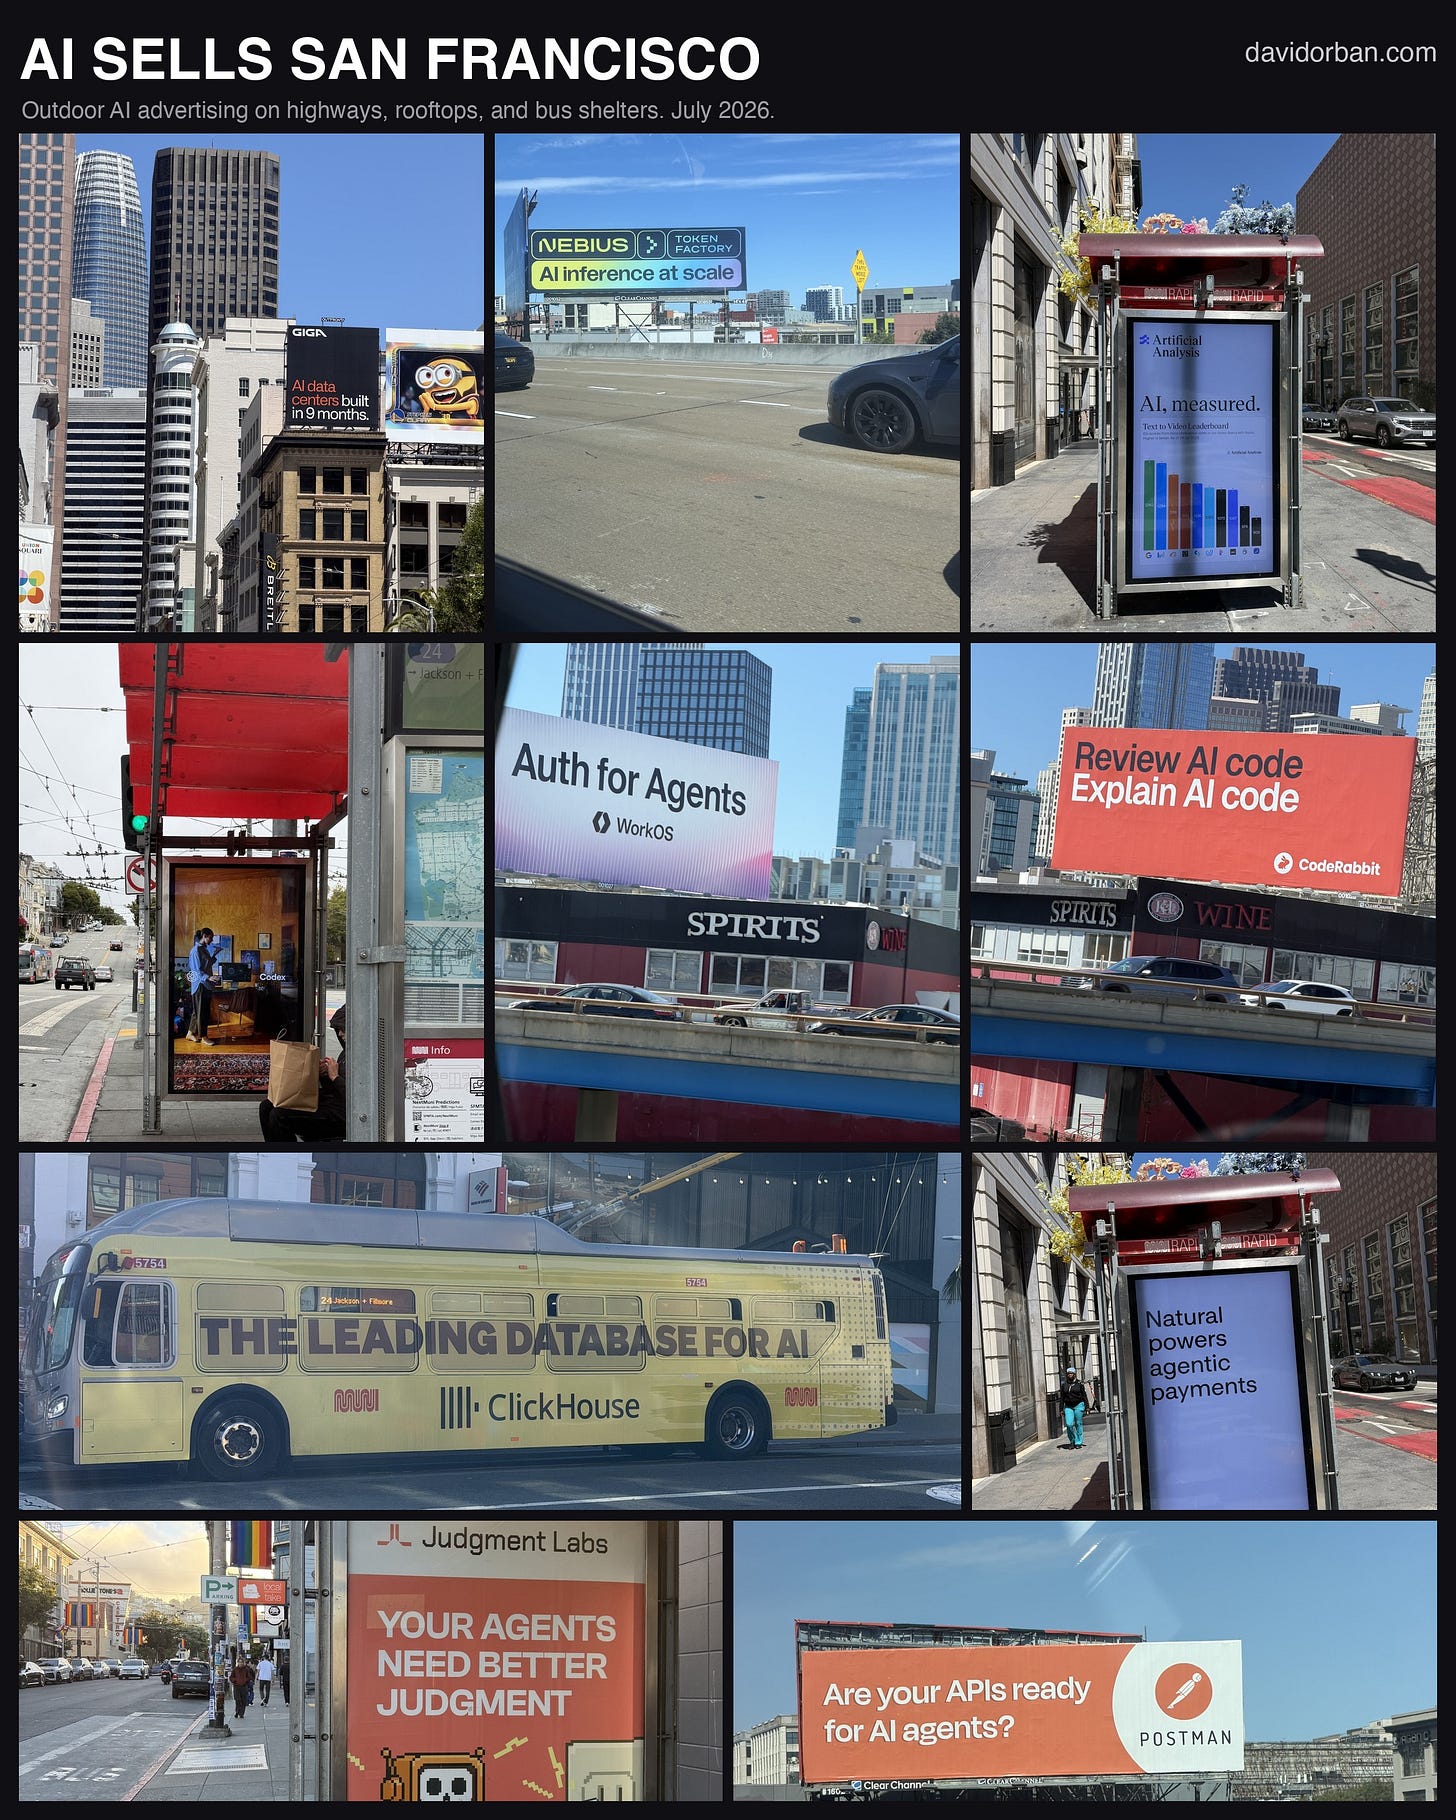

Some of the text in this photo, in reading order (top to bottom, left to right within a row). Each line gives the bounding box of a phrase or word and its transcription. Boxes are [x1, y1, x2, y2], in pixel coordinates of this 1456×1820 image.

[538, 238, 628, 253] NEBIUS
[675, 235, 719, 244] TOKEN
[675, 244, 734, 254] FACTORY
[540, 264, 734, 282] AI inference at scale
[1168, 288, 1193, 300] RAPI
[1233, 290, 1264, 302] RAPID
[292, 328, 327, 338] GIGA
[1153, 335, 1202, 346] Artificial
[1153, 347, 1200, 360] Analysis
[292, 380, 337, 393] AI data
[291, 394, 370, 407] centers built
[1140, 396, 1261, 413] AI, measured.
[292, 407, 370, 421] in 9 months.
[266, 575, 275, 631] BREITL
[423, 643, 442, 659] 24
[420, 666, 462, 680] Jackson
[1074, 741, 1304, 779] Review AI code
[511, 743, 747, 816] Auth for Agents
[1071, 773, 1299, 813] Explain AI code
[616, 817, 674, 842] WorkOS
[1298, 858, 1381, 876] CodeRabbit
[1050, 899, 1117, 928] SPIRITS
[1194, 901, 1273, 931] WINE
[687, 911, 822, 945] SPIRITS
[881, 927, 907, 951] WINE
[259, 973, 286, 981] Codex
[431, 1045, 451, 1055] Info
[1171, 1238, 1198, 1252] RAPI
[1243, 1233, 1277, 1248] RAPID
[135, 1258, 165, 1268] 5754
[686, 1278, 707, 1287] 5754
[321, 1296, 332, 1305] 24
[333, 1297, 359, 1305] Jackson
[1146, 1306, 1223, 1329] Natural
[199, 1318, 809, 1359] THE LEADING DATABASE FOR AI
[1148, 1332, 1227, 1356] powers
[1150, 1354, 1230, 1380] agentic
[1151, 1377, 1257, 1405] payments
[488, 1392, 640, 1421] ClickHouse
[422, 1524, 609, 1556] Judgment Labs
[377, 1610, 617, 1642] YOUR AGENTS
[377, 1649, 608, 1679] NEED BETTER
[376, 1687, 573, 1718] JUDGMENT
[823, 1675, 1092, 1712] Are your APIs ready
[824, 1715, 1015, 1747] for AI agents?
[1140, 1729, 1232, 1747] POSTMAN
[39, 1767, 127, 1782] BUS
[864, 1781, 889, 1790] Clear
